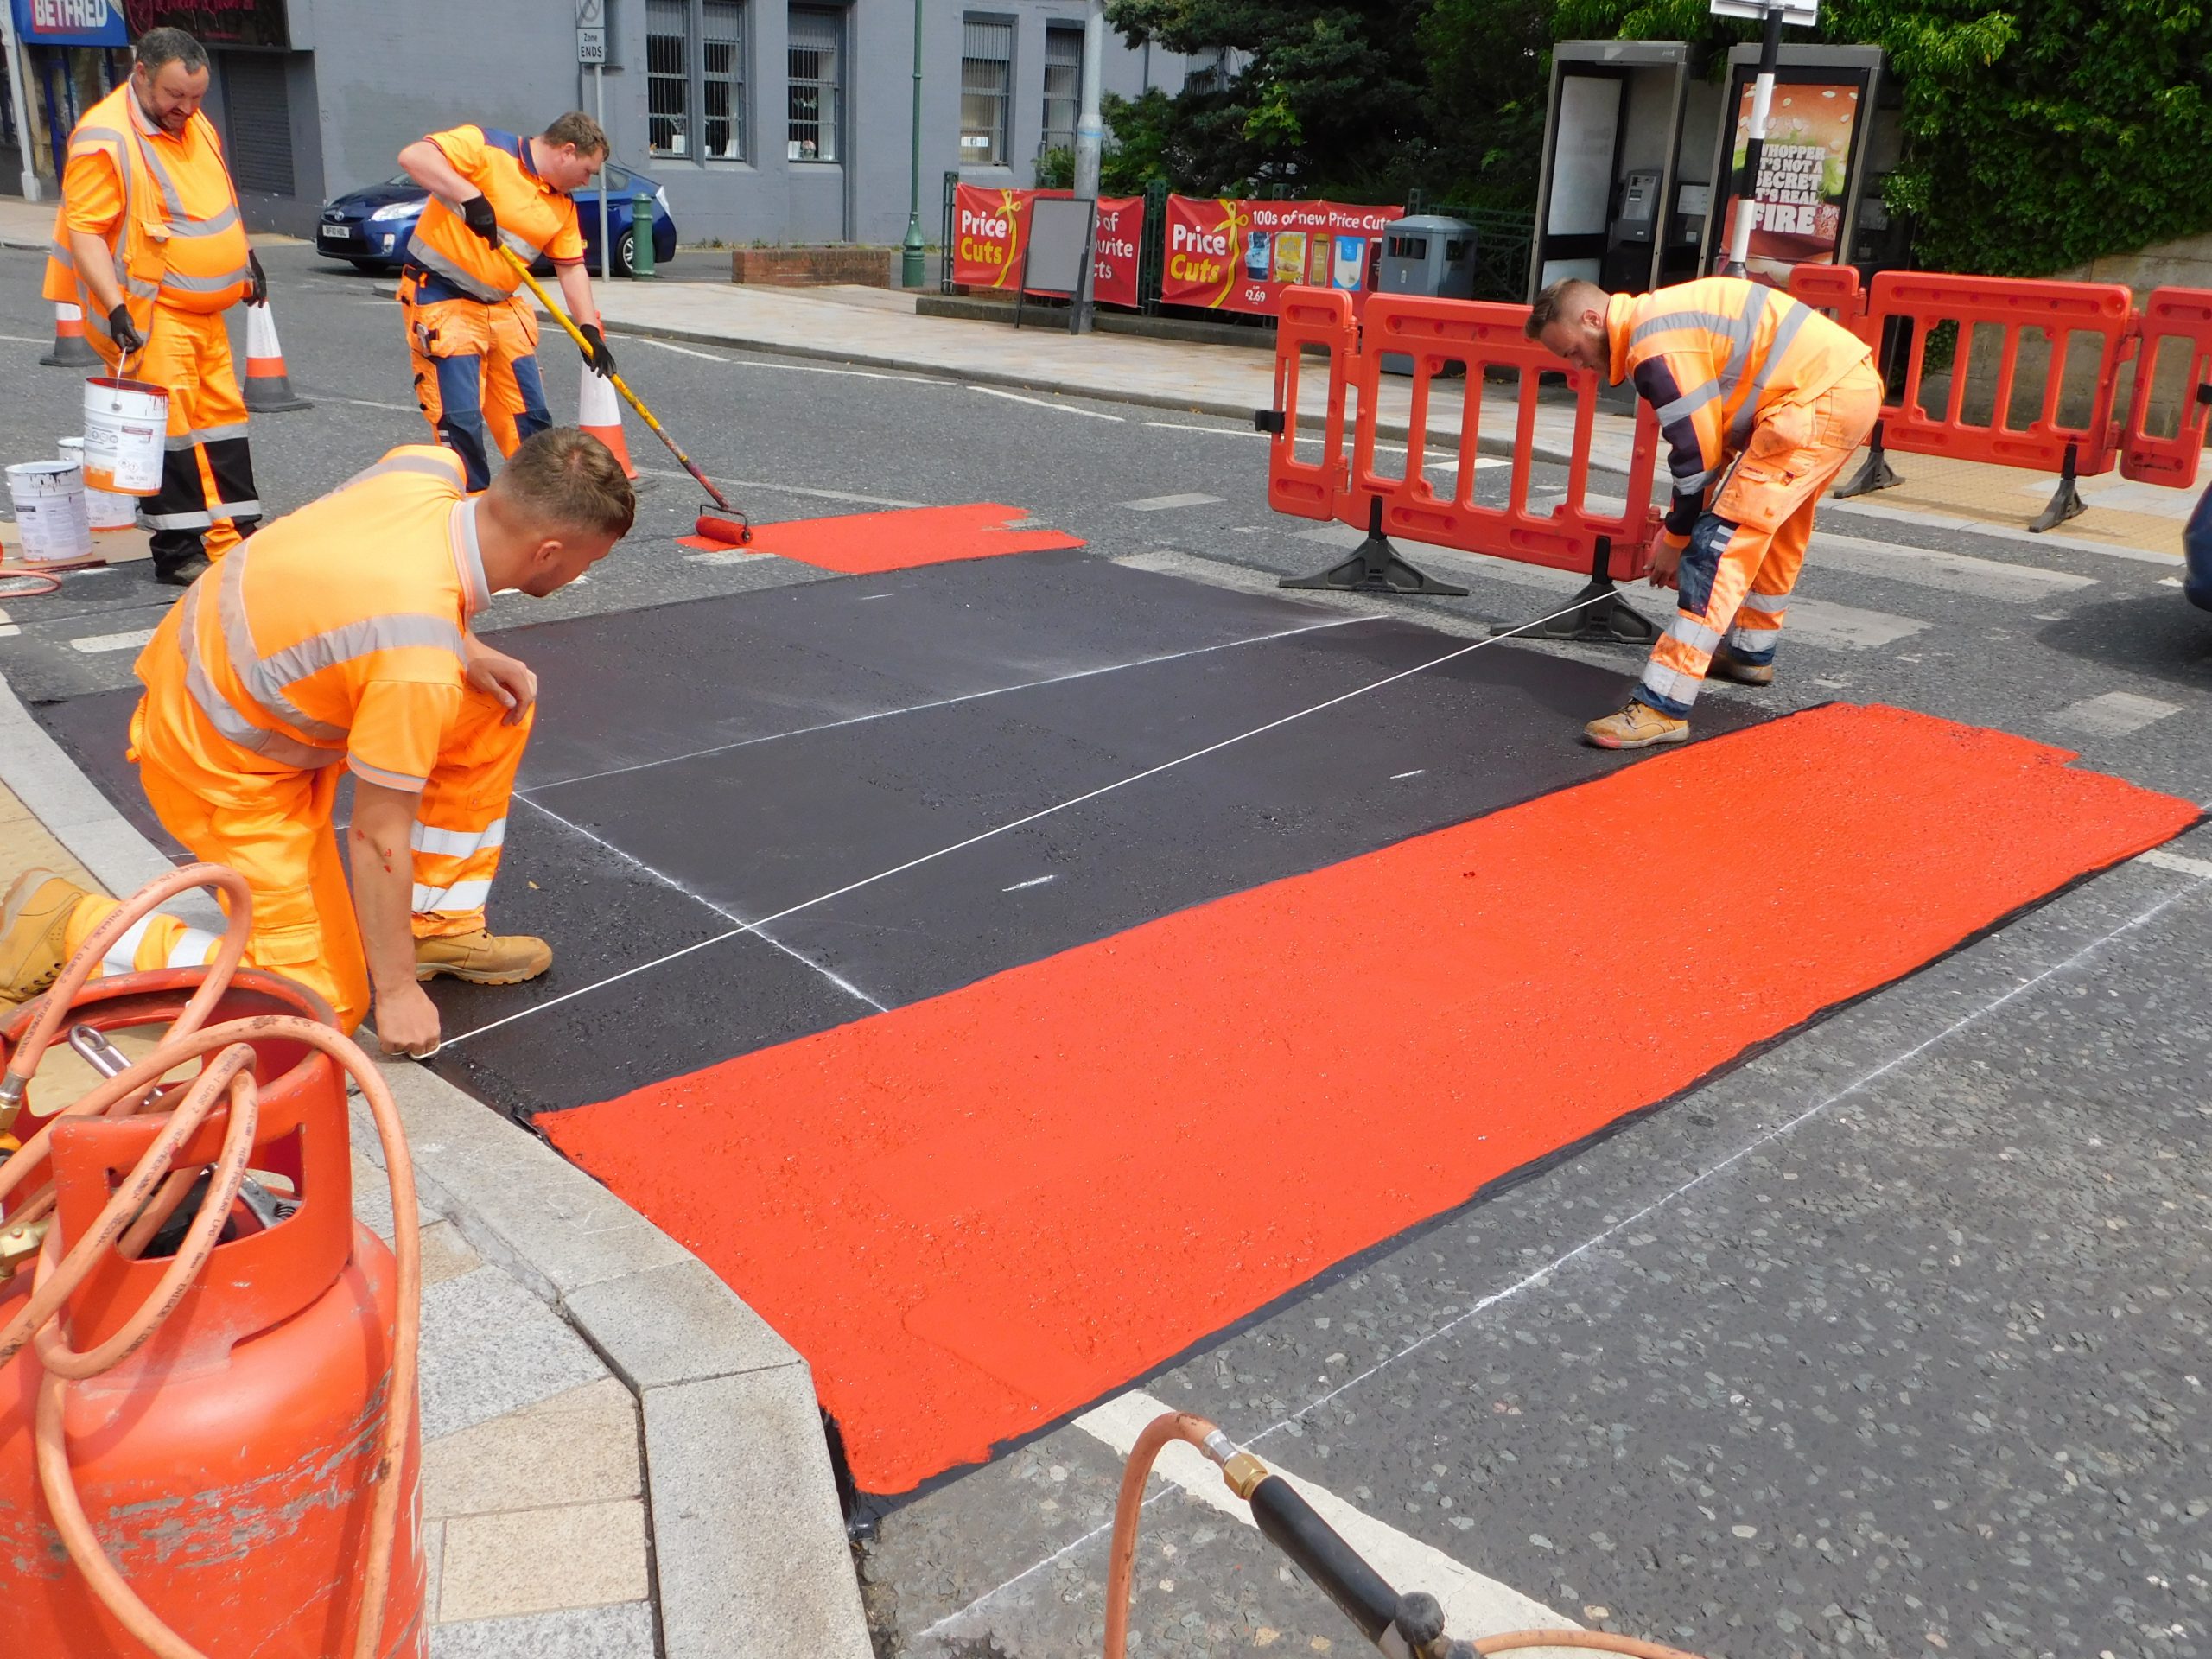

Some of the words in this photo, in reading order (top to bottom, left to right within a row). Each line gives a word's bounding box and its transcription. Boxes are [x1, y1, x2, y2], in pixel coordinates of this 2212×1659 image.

[35, 0, 107, 27] BETFRED
[583, 33, 598, 42] Zone
[581, 46, 602, 58] ENDS
[1759, 157, 1781, 171] T'S
[1782, 159, 1813, 173] NOT
[1813, 160, 1824, 174] A
[1755, 188, 1779, 203] T'S
[1779, 189, 1819, 206] REAL
[961, 209, 1007, 238] Price
[1103, 212, 1119, 232] of
[1253, 210, 1278, 225] 100s
[1281, 210, 1297, 225] of
[1299, 213, 1326, 225] new
[1328, 211, 1360, 229] Price
[1751, 202, 1816, 235] FIRE
[1172, 223, 1226, 256] Price
[960, 237, 1003, 264] Cuts
[1170, 255, 1220, 283] Cuts
[1245, 289, 1266, 302] £2.69
